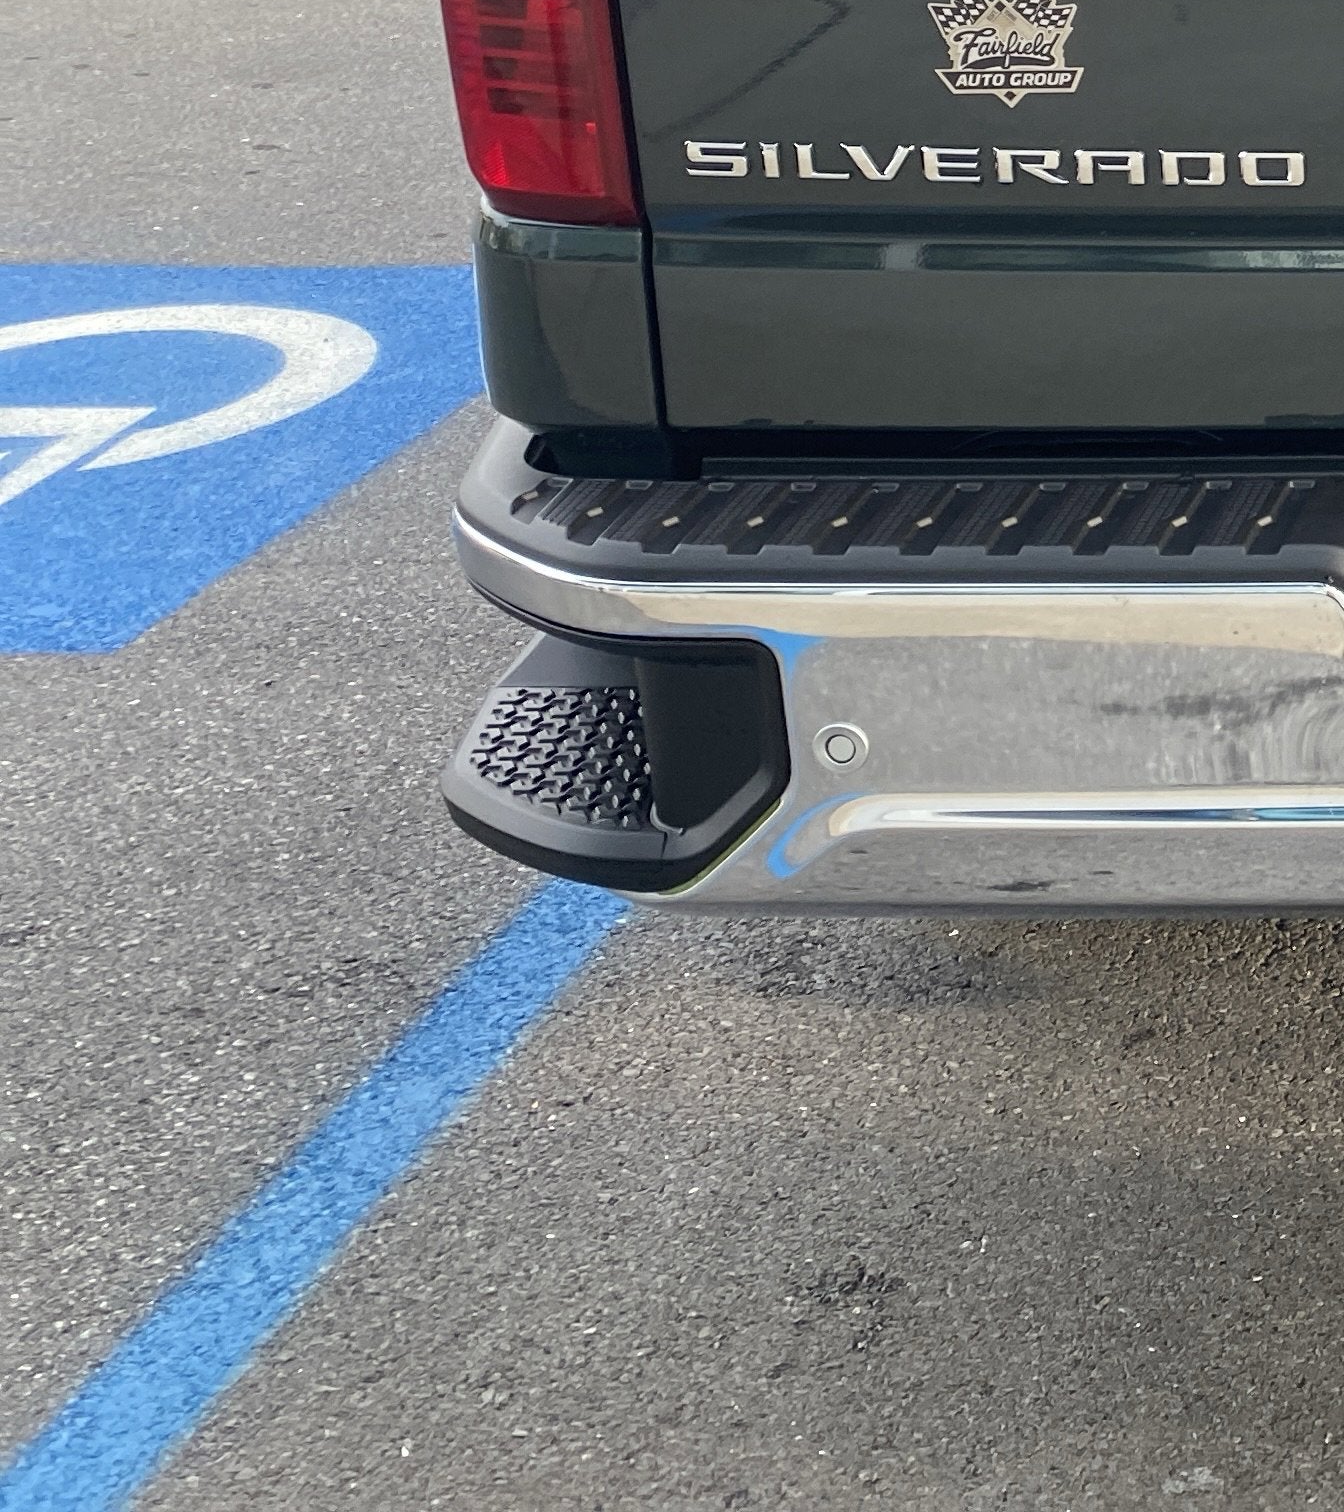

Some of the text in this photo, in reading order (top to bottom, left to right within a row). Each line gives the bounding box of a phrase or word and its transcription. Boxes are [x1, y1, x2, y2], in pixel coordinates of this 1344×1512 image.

[953, 27, 1061, 69] Fairfield
[955, 72, 1073, 88] AUTO GROUP
[683, 139, 1307, 187] SILVERADO
